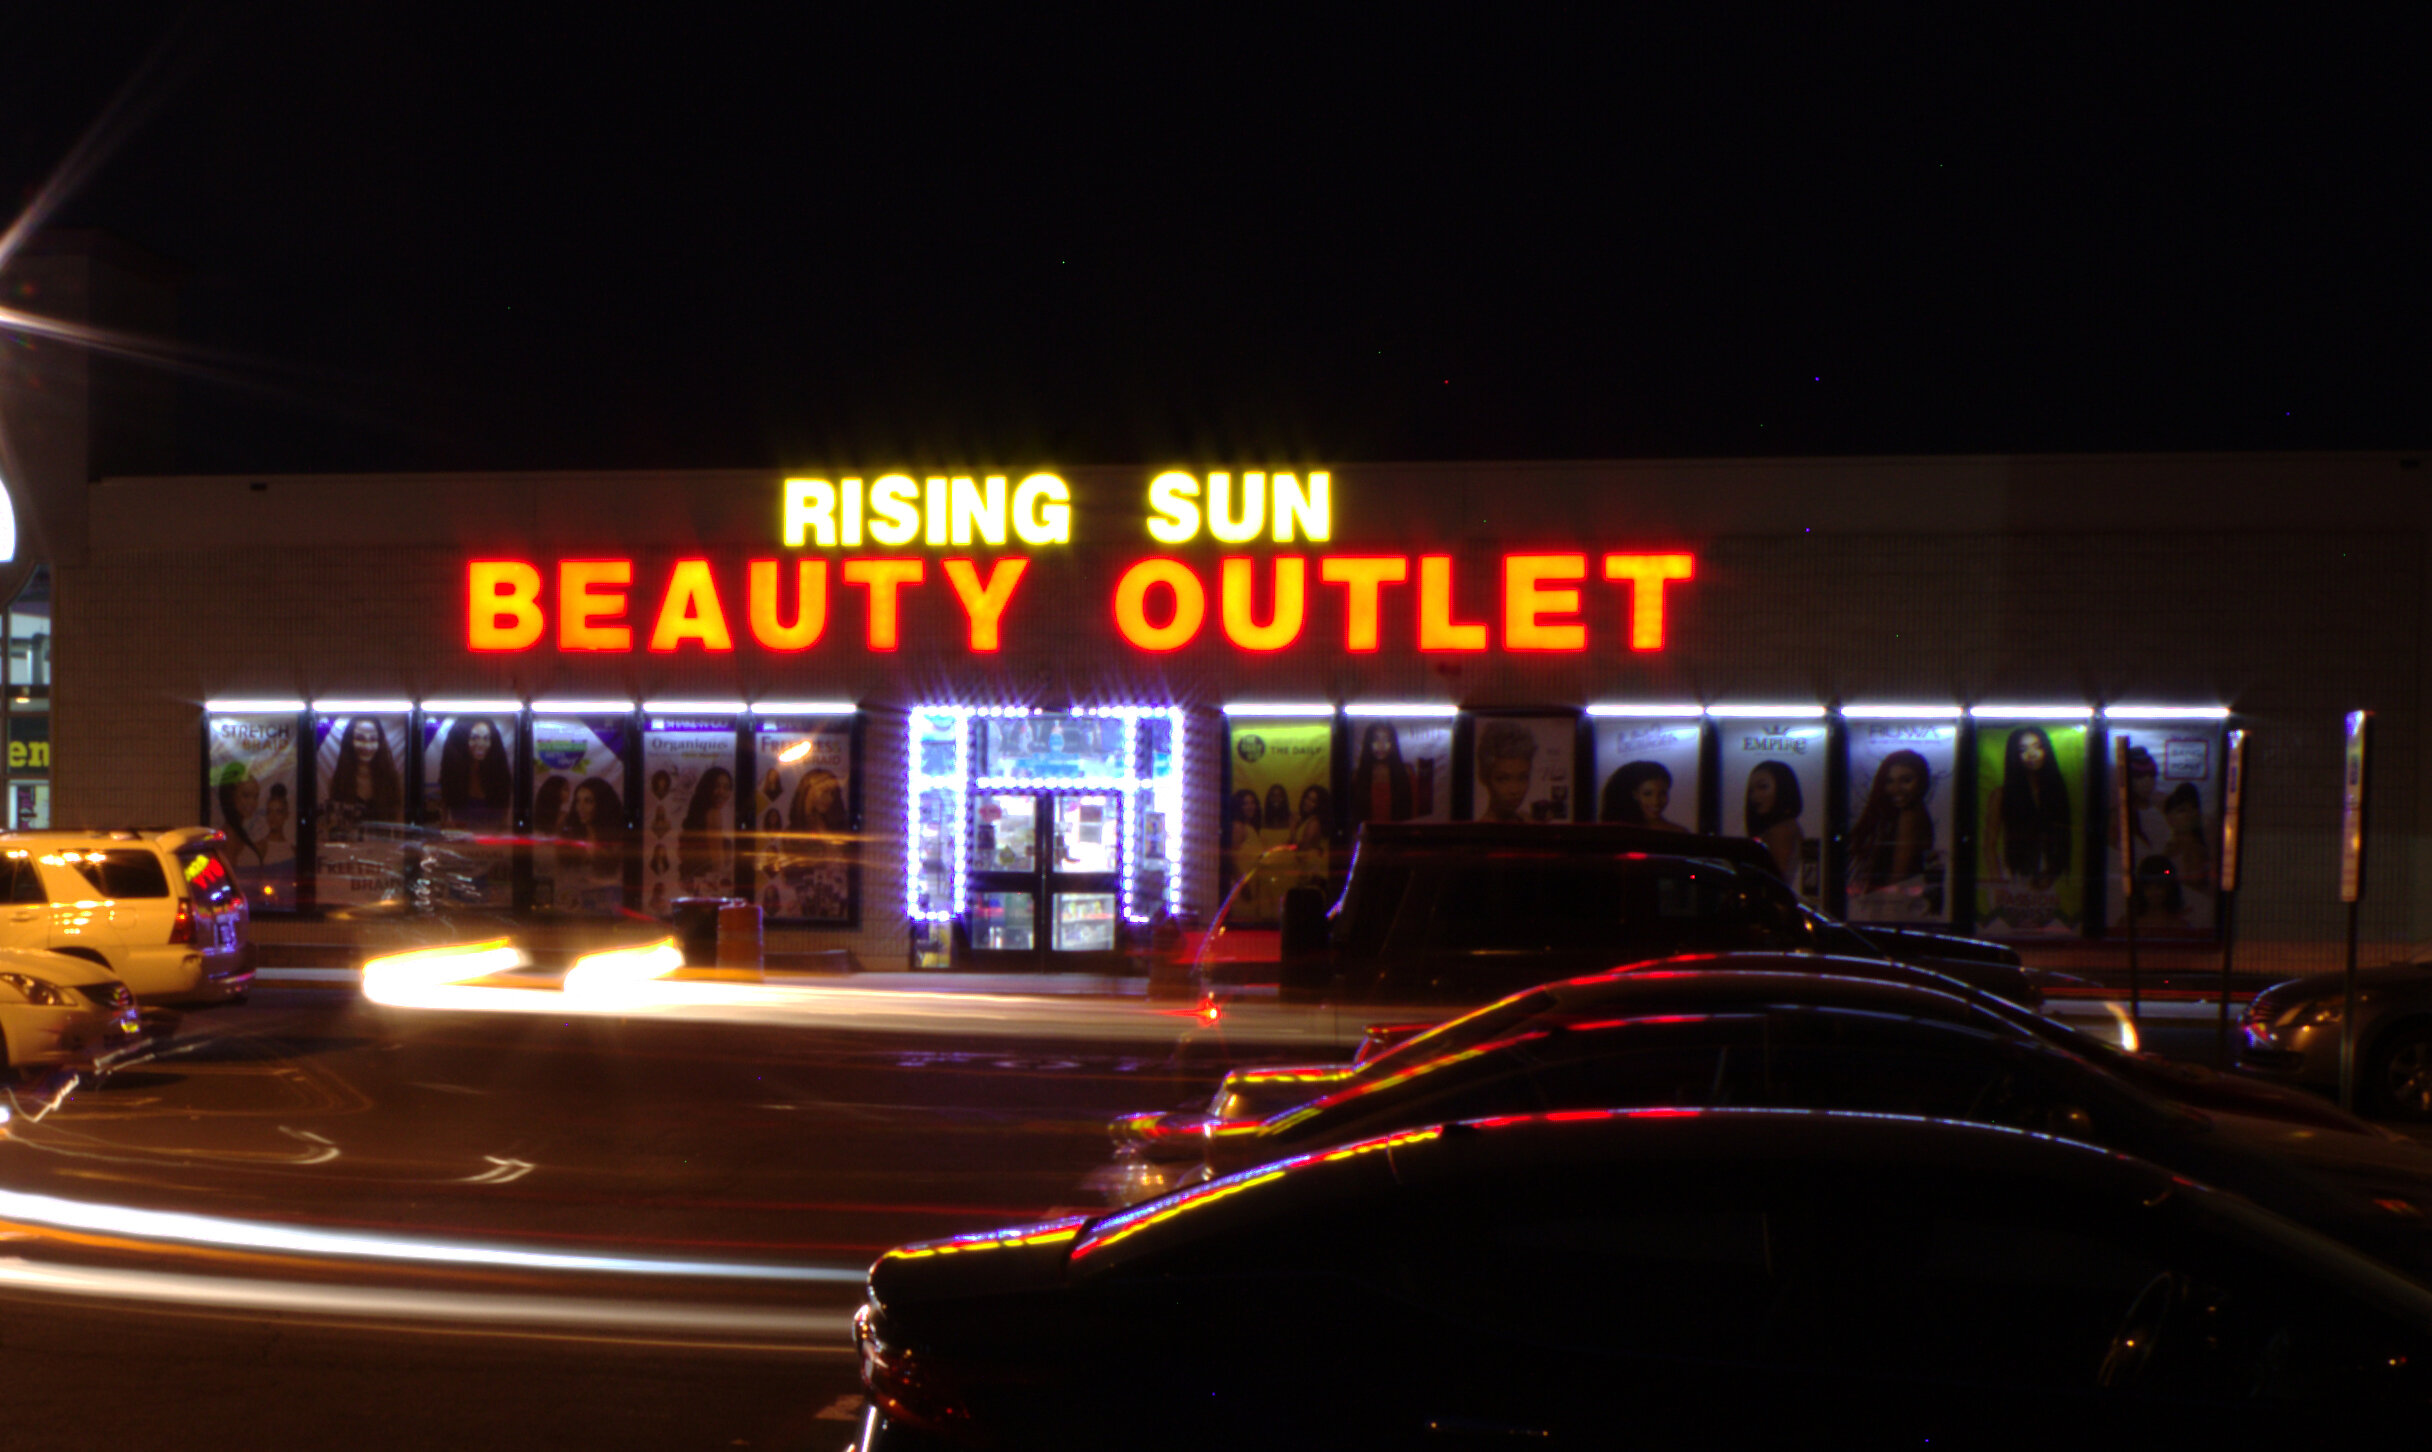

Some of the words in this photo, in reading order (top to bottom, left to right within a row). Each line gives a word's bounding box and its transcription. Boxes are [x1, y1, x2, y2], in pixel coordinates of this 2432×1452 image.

[784, 473, 1071, 546] RISING
[1147, 471, 1330, 543] SUN
[469, 558, 1028, 650] BEAUTY
[1115, 555, 1692, 650] OUTLET
[221, 724, 290, 738] STRETCH
